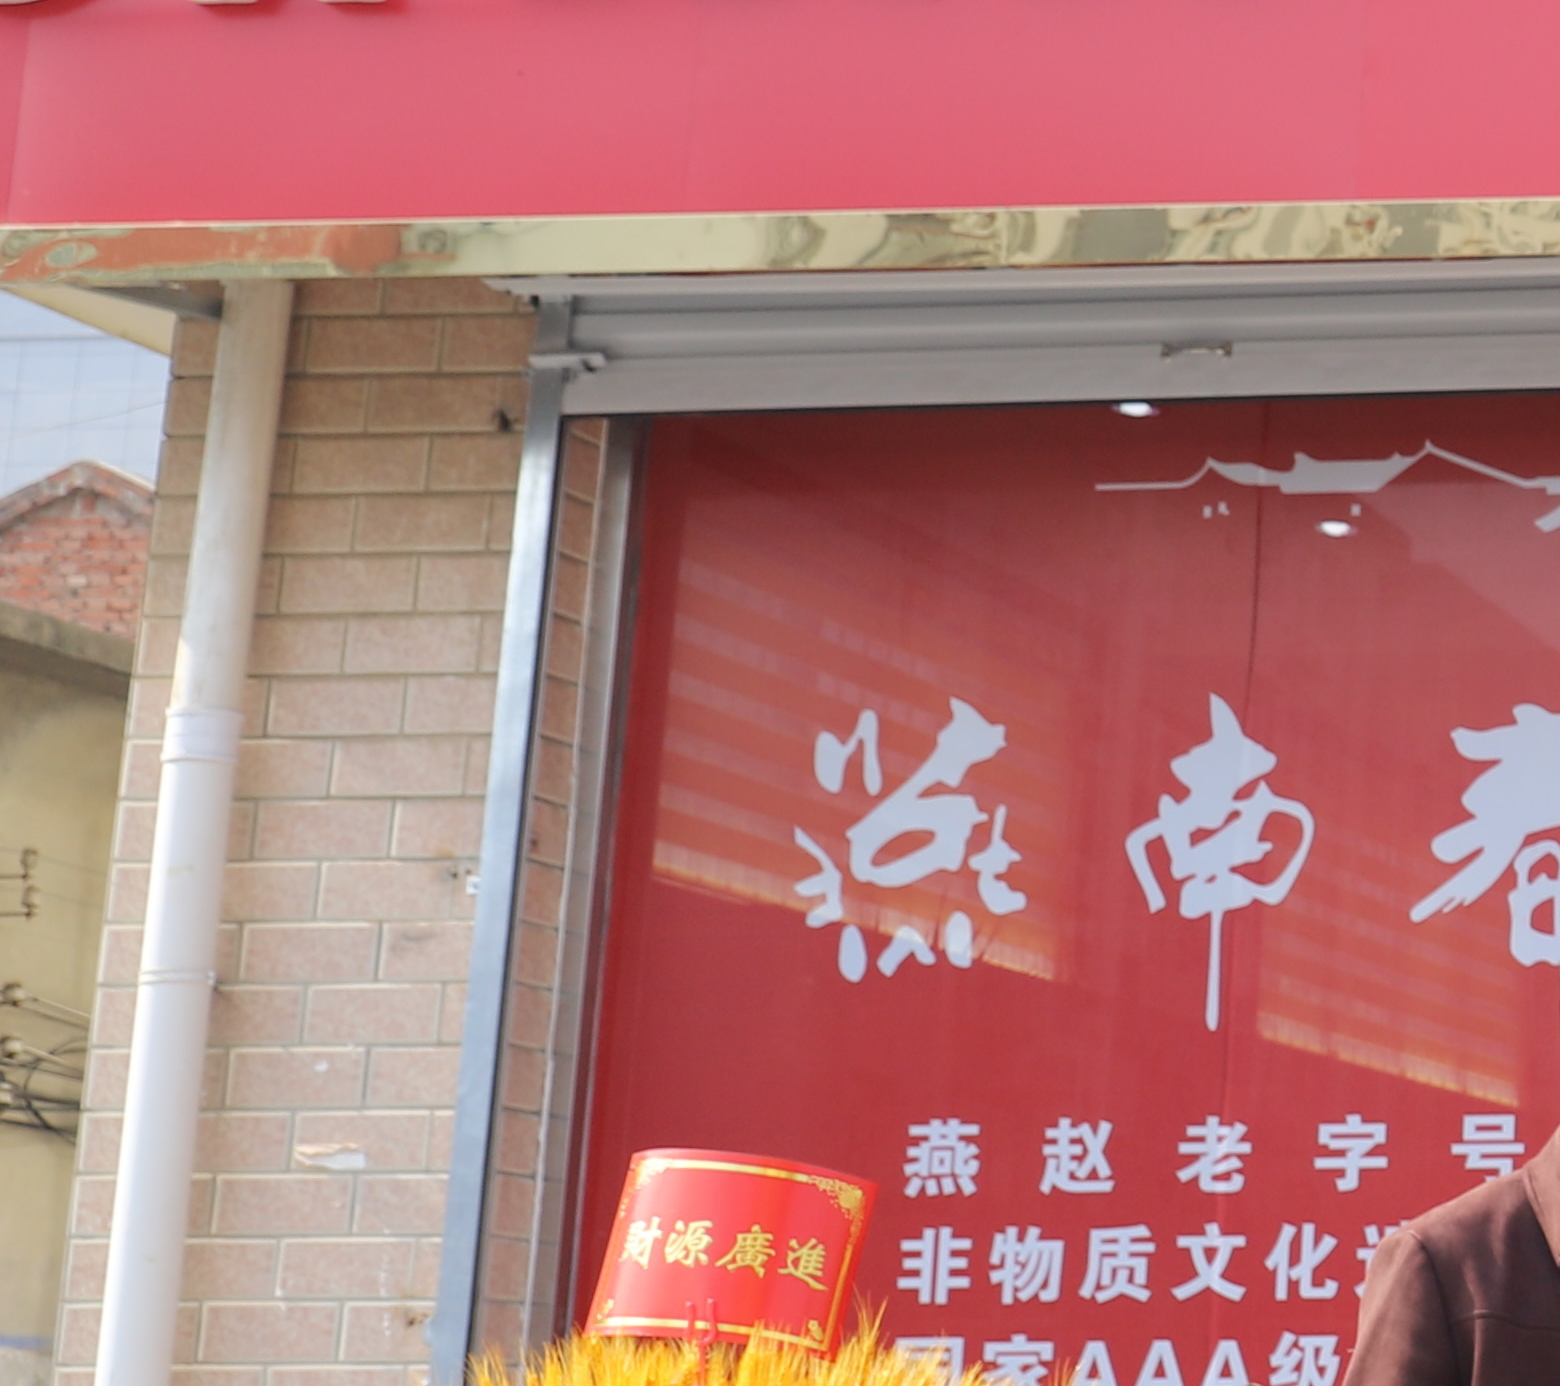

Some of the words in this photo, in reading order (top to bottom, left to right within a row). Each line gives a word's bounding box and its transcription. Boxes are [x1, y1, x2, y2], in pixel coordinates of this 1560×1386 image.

[903, 1113, 1526, 1198] 燕赵老字号
[619, 1216, 829, 1291] 財源廣進
